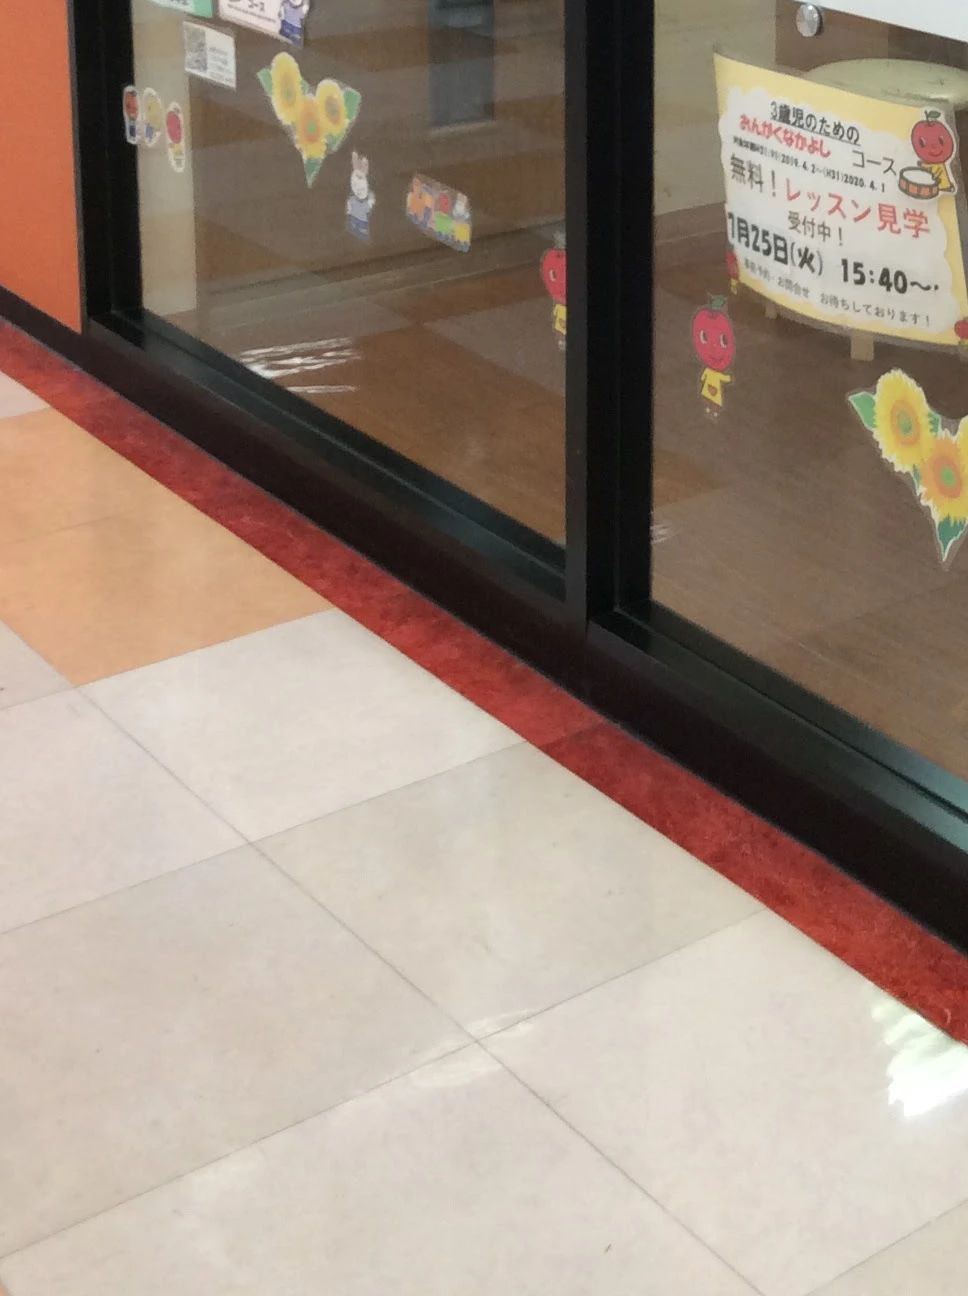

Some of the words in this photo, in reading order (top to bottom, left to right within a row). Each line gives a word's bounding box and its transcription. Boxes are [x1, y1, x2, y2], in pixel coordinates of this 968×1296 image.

[740, 114, 831, 158] おんがくなかよし
[770, 101, 861, 144] 3歳児のための
[852, 149, 897, 176] コース
[788, 210, 844, 247] 受付中！
